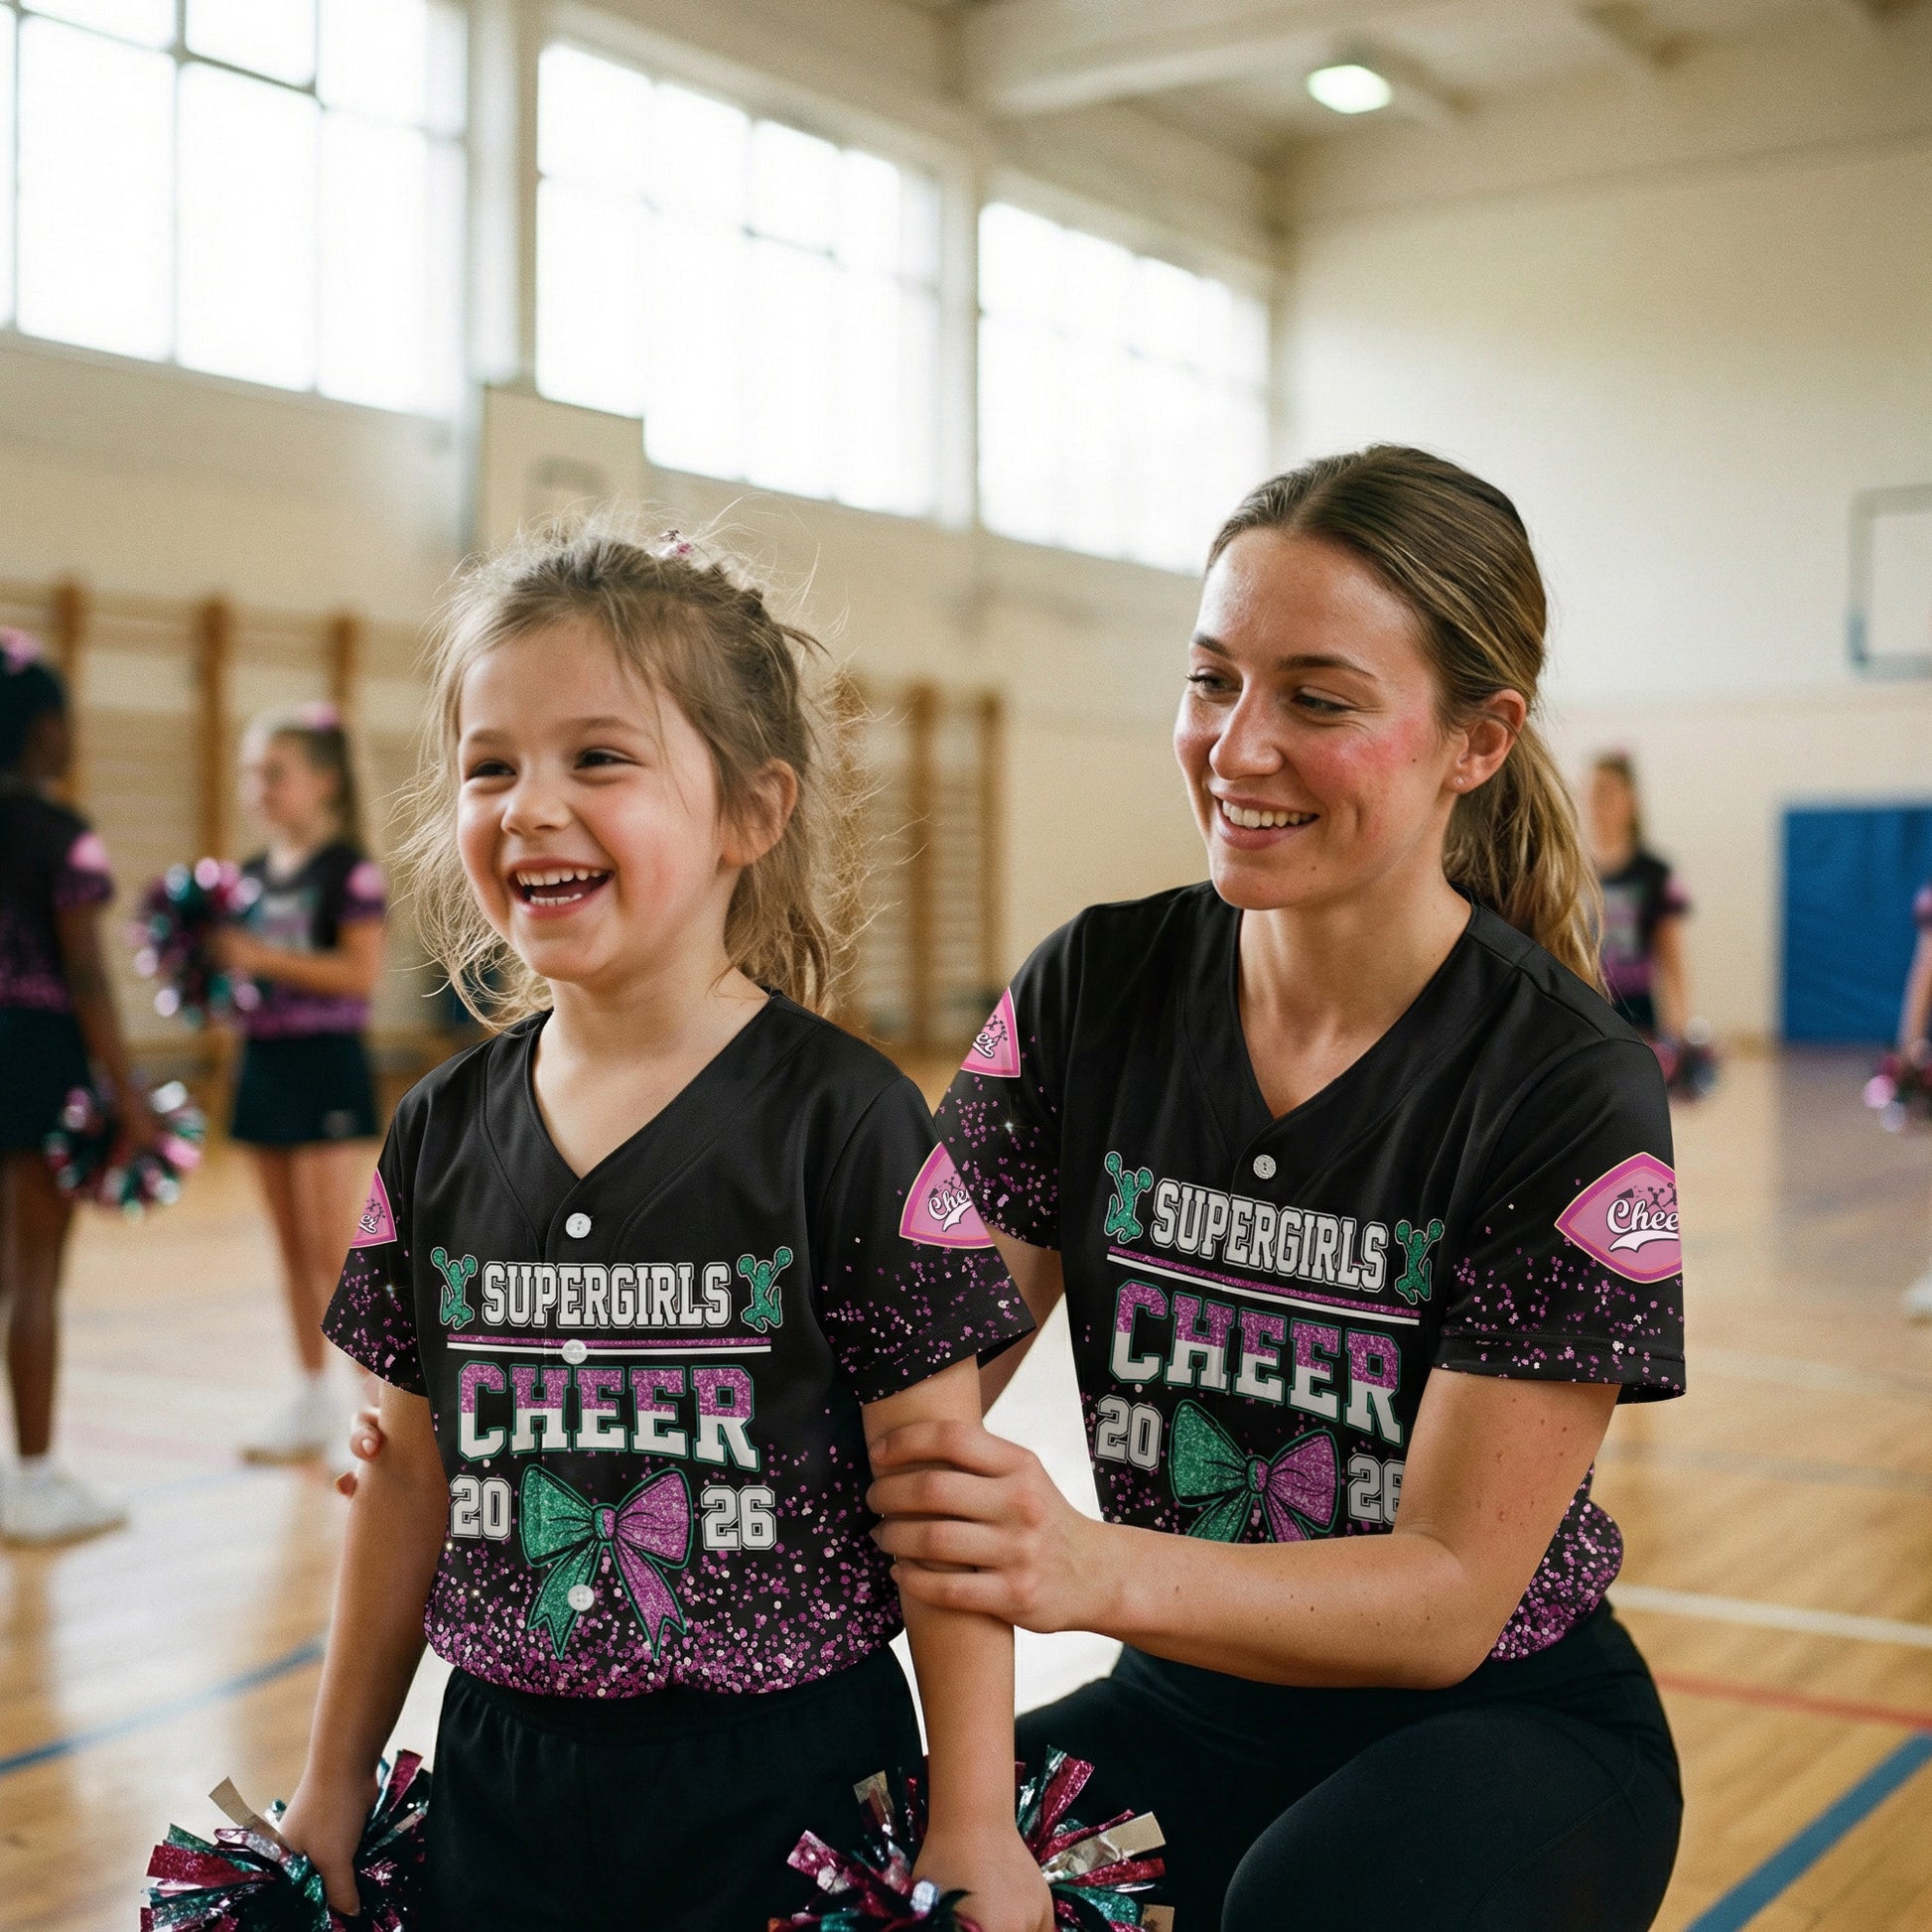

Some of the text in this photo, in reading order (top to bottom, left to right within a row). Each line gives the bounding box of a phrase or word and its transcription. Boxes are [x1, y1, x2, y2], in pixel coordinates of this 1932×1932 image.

[1150, 1178, 1389, 1294] SUPERGIRLS
[482, 1262, 732, 1327] SUPERGIRLS
[1109, 1280, 1404, 1447] CHEER
[458, 1360, 759, 1471] CHEER
[1095, 1394, 1164, 1471] 20
[449, 1474, 776, 1551] 20 26
